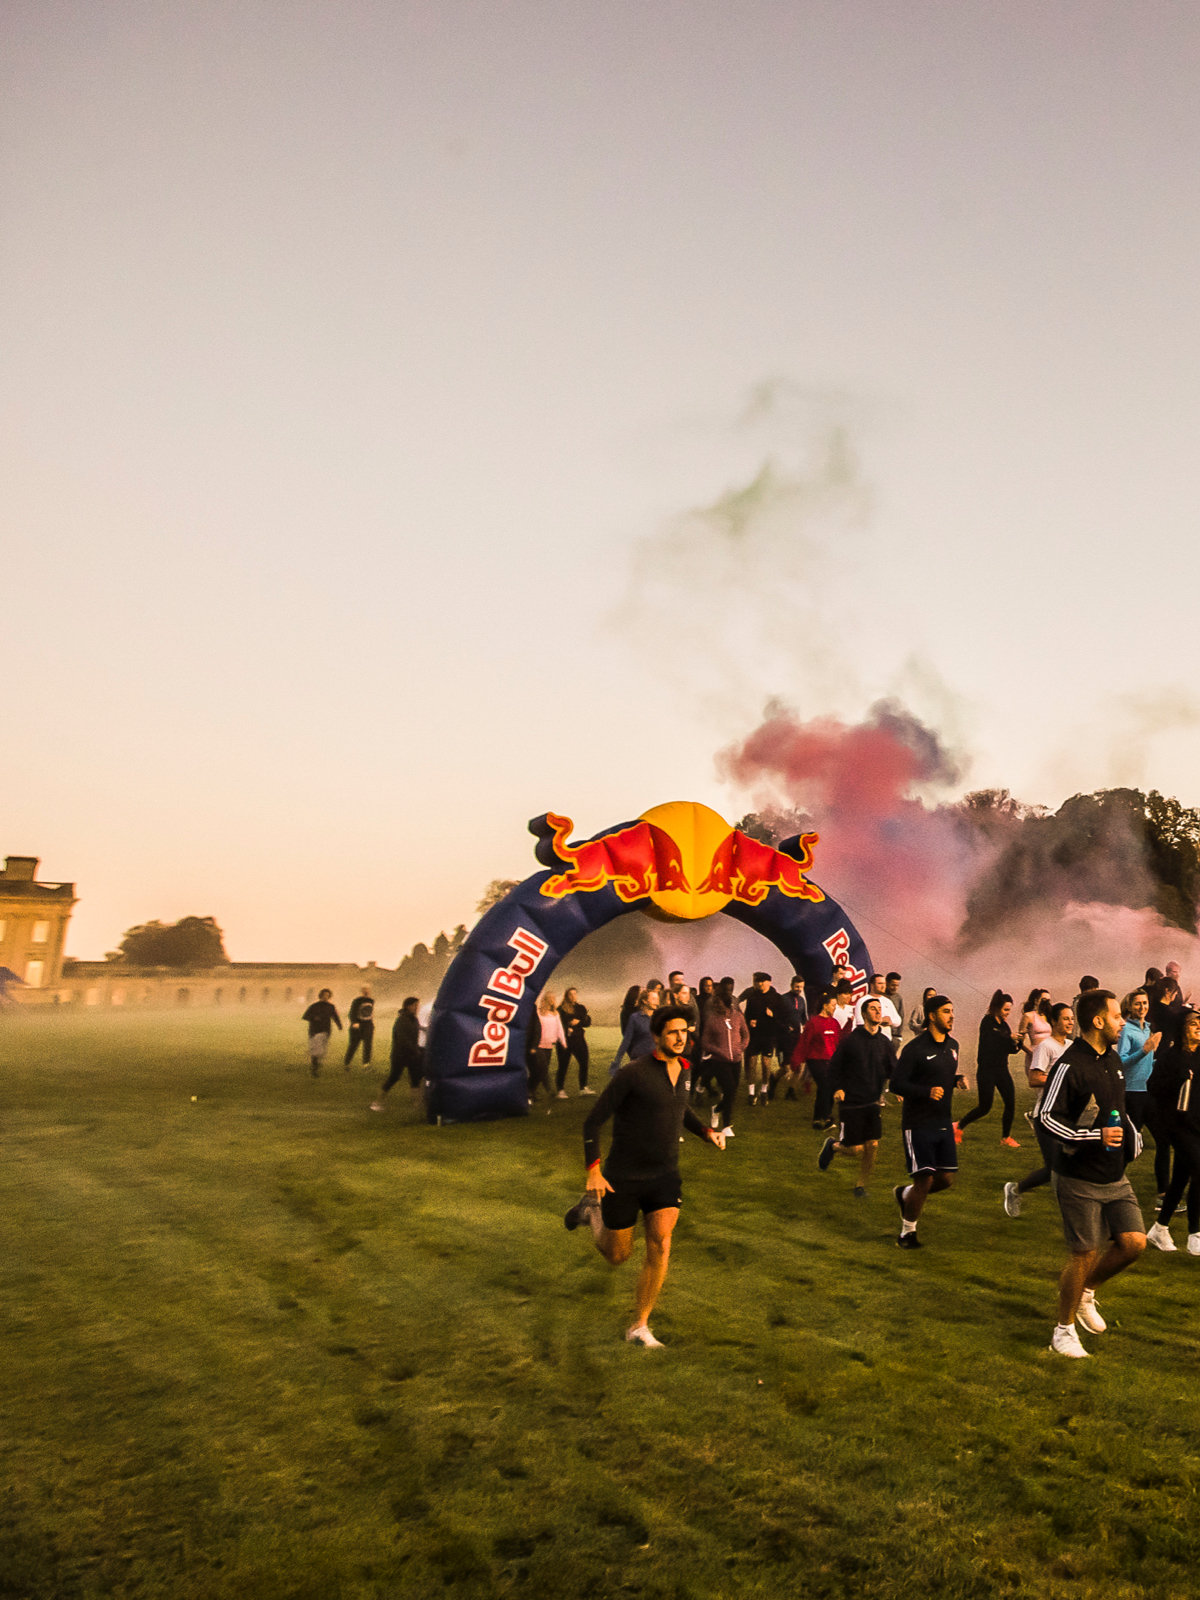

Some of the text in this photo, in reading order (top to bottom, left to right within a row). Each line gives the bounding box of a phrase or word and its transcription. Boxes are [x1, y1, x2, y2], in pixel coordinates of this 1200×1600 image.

[469, 928, 547, 1065] Red Bull
[823, 928, 866, 985] Red
